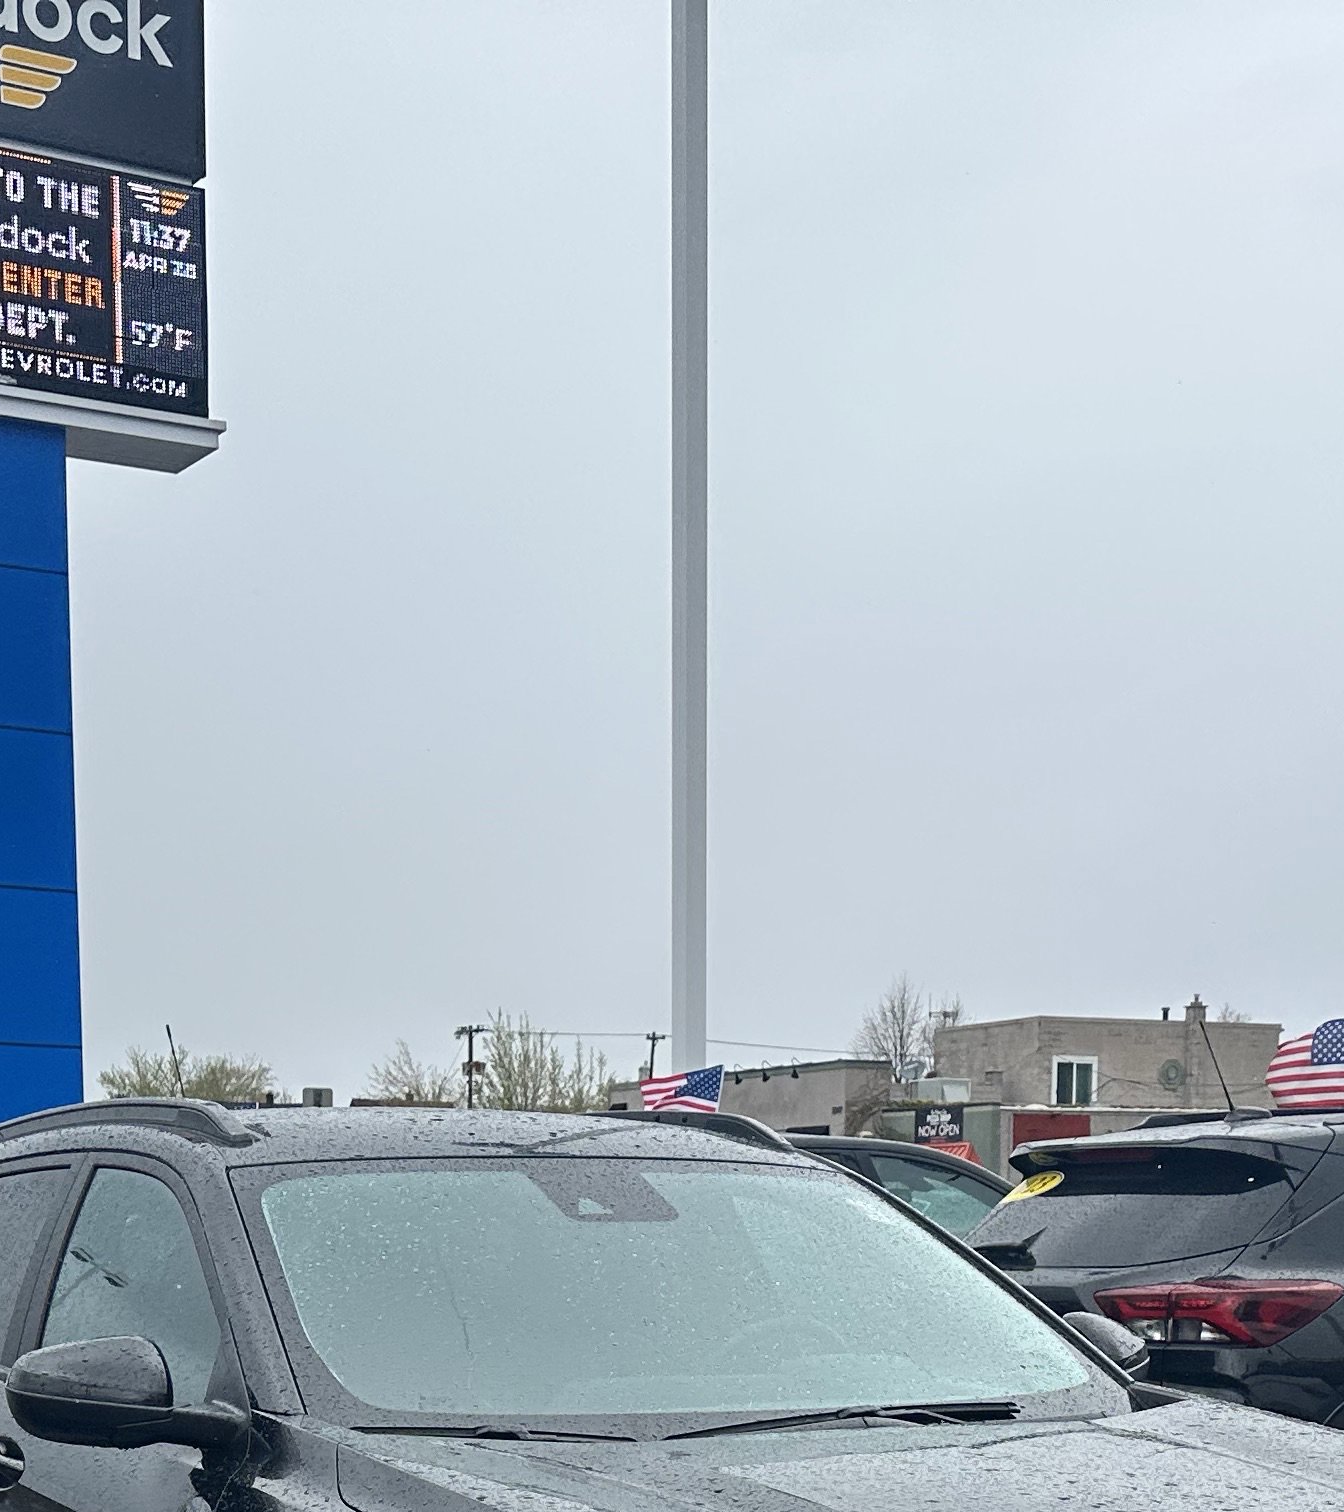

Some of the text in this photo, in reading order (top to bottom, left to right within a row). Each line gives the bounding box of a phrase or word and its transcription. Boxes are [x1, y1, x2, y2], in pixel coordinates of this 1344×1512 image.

[36, 175, 100, 220] THE
[123, 250, 168, 274] APR
[918, 1123, 960, 1137] NOW OPEN
